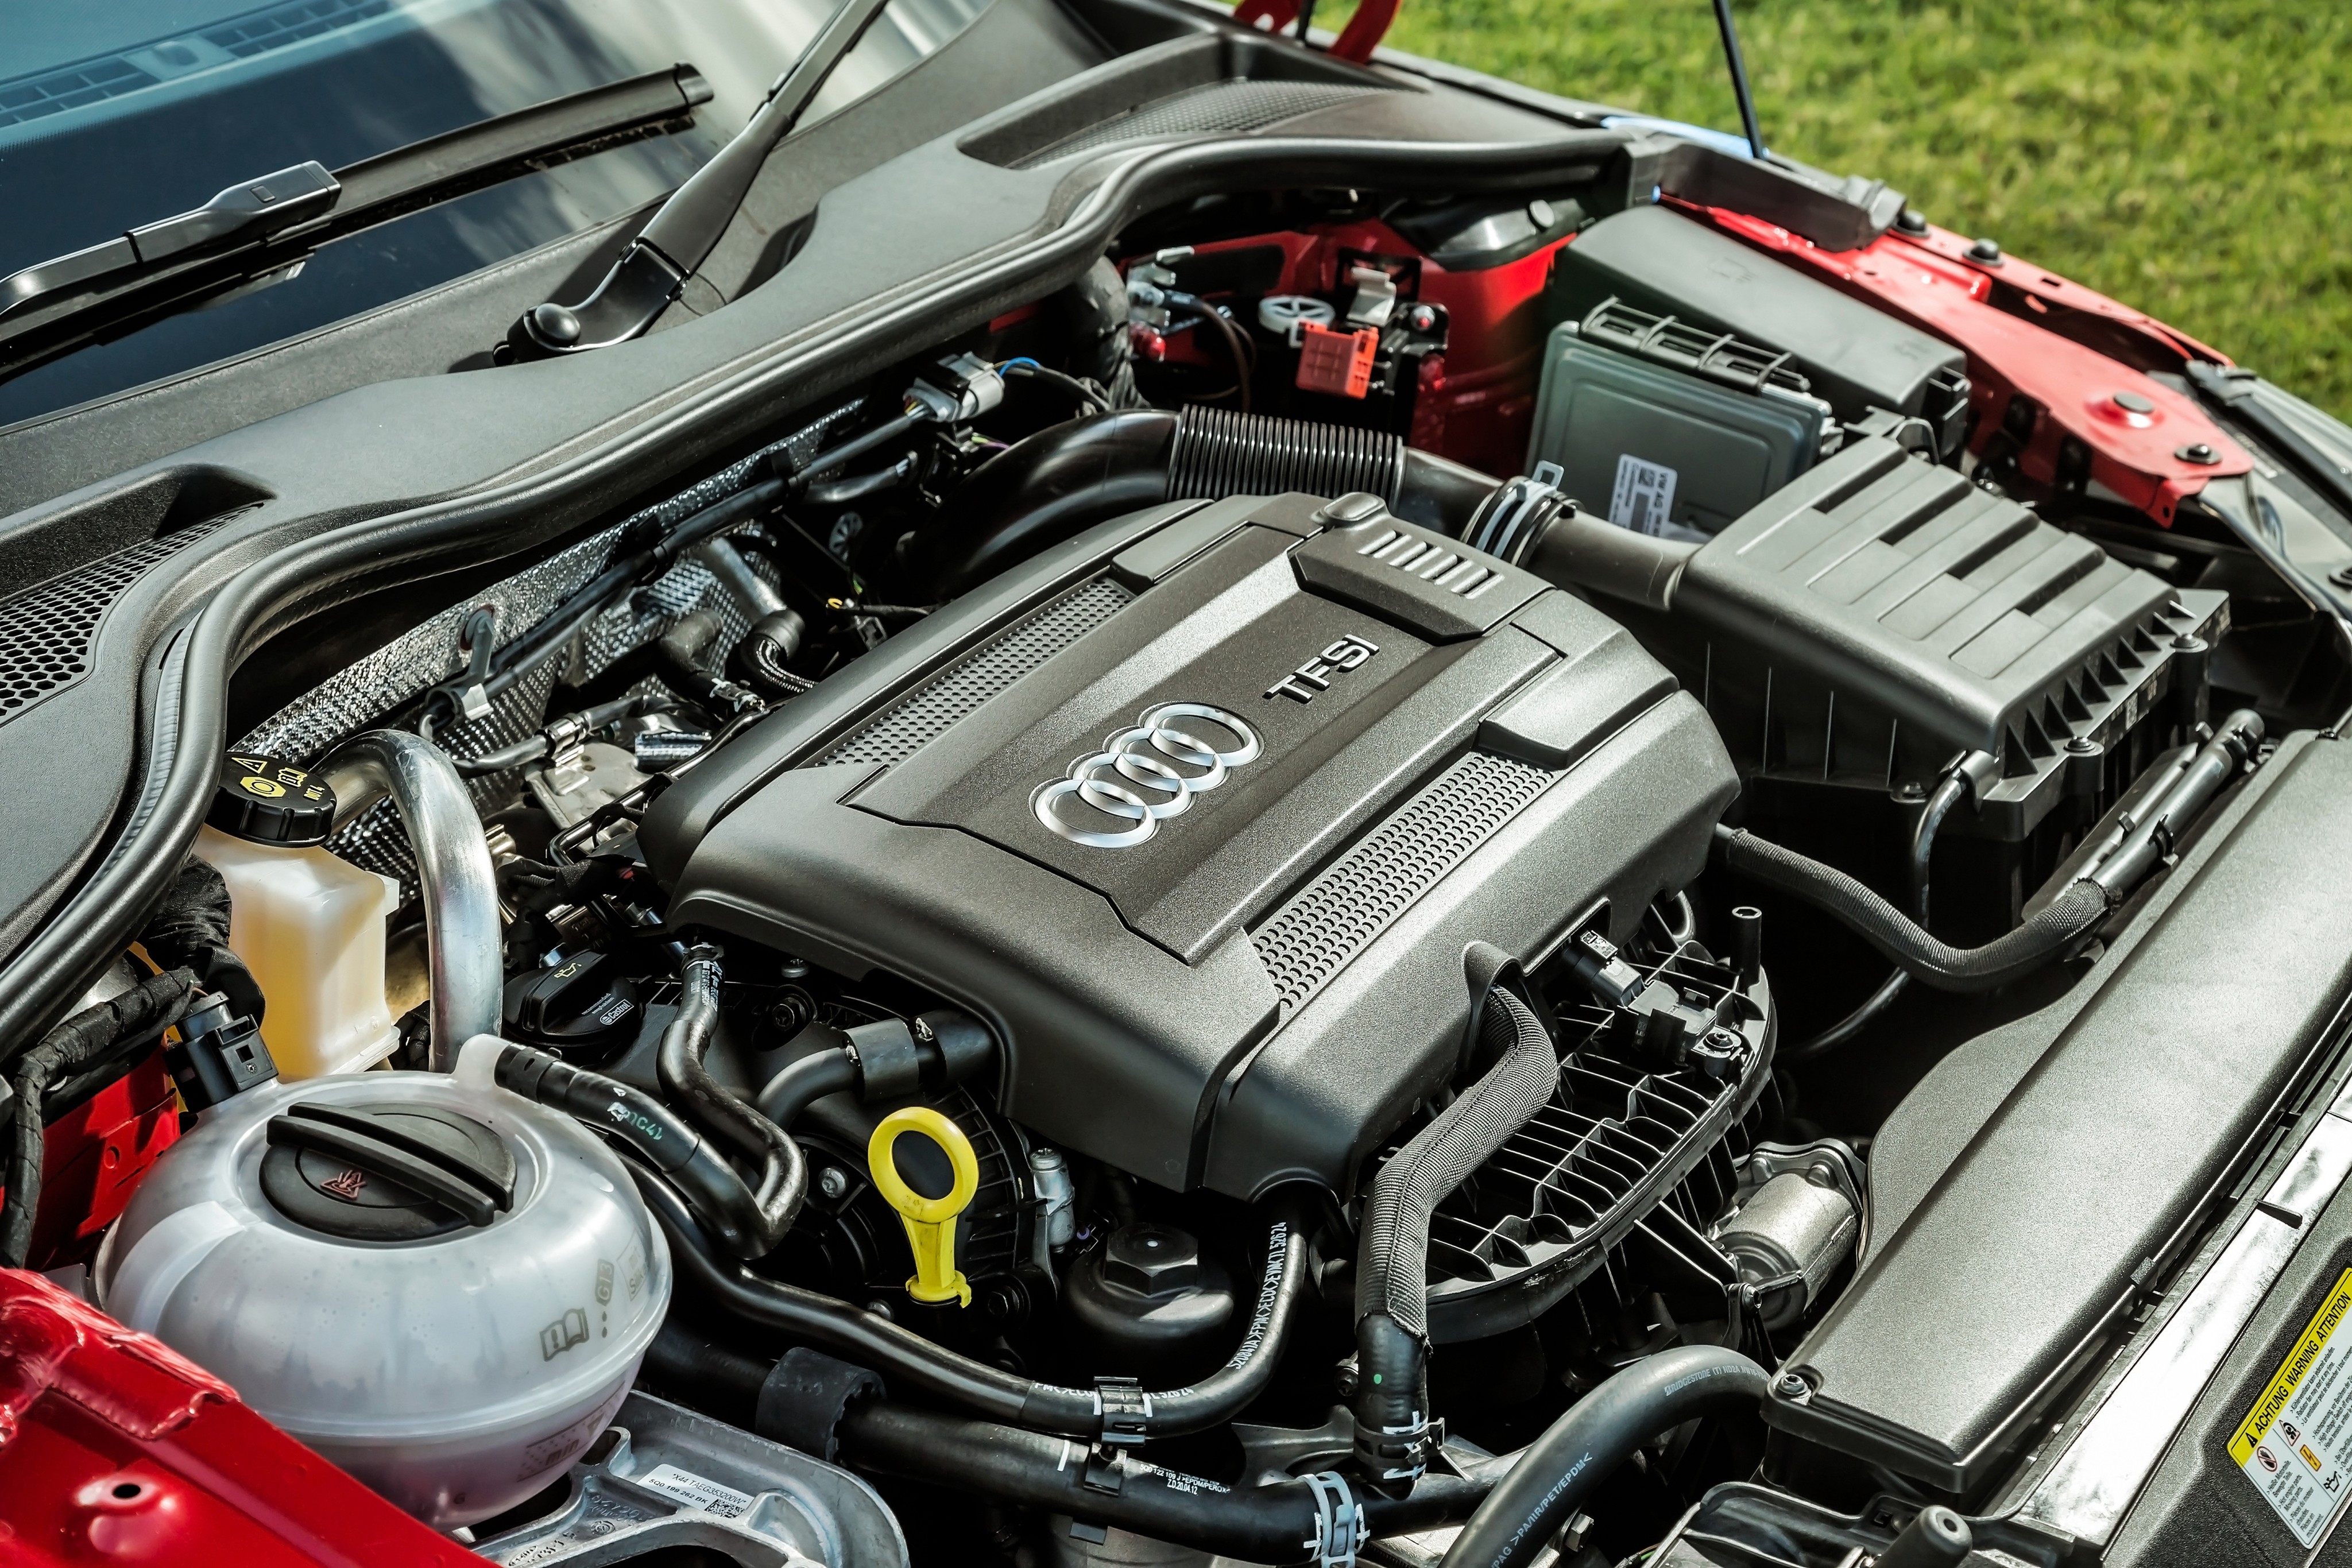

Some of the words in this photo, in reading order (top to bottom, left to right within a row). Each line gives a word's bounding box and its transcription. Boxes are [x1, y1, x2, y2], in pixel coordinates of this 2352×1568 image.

[1263, 634, 1380, 703] TFSI
[303, 787, 323, 801] DOT
[608, 1002, 630, 1019] Castrol
[598, 1263, 613, 1300] G13
[2254, 1385, 2288, 1434] ACHTUNG
[2286, 1339, 2318, 1386] WARNING
[2316, 1291, 2350, 1341] ATTENTION
[1665, 1369, 1711, 1396] BRIDGESTONE
[2297, 1400, 2308, 1415] Radiator
[2319, 1432, 2327, 1443] High
[2334, 1406, 2343, 1419] Switch
[1154, 1468, 1165, 1477] 122
[1165, 1472, 1176, 1480] 109
[649, 1478, 665, 1487] 5Q0
[680, 1490, 695, 1499] 262
[695, 1495, 709, 1504] BK
